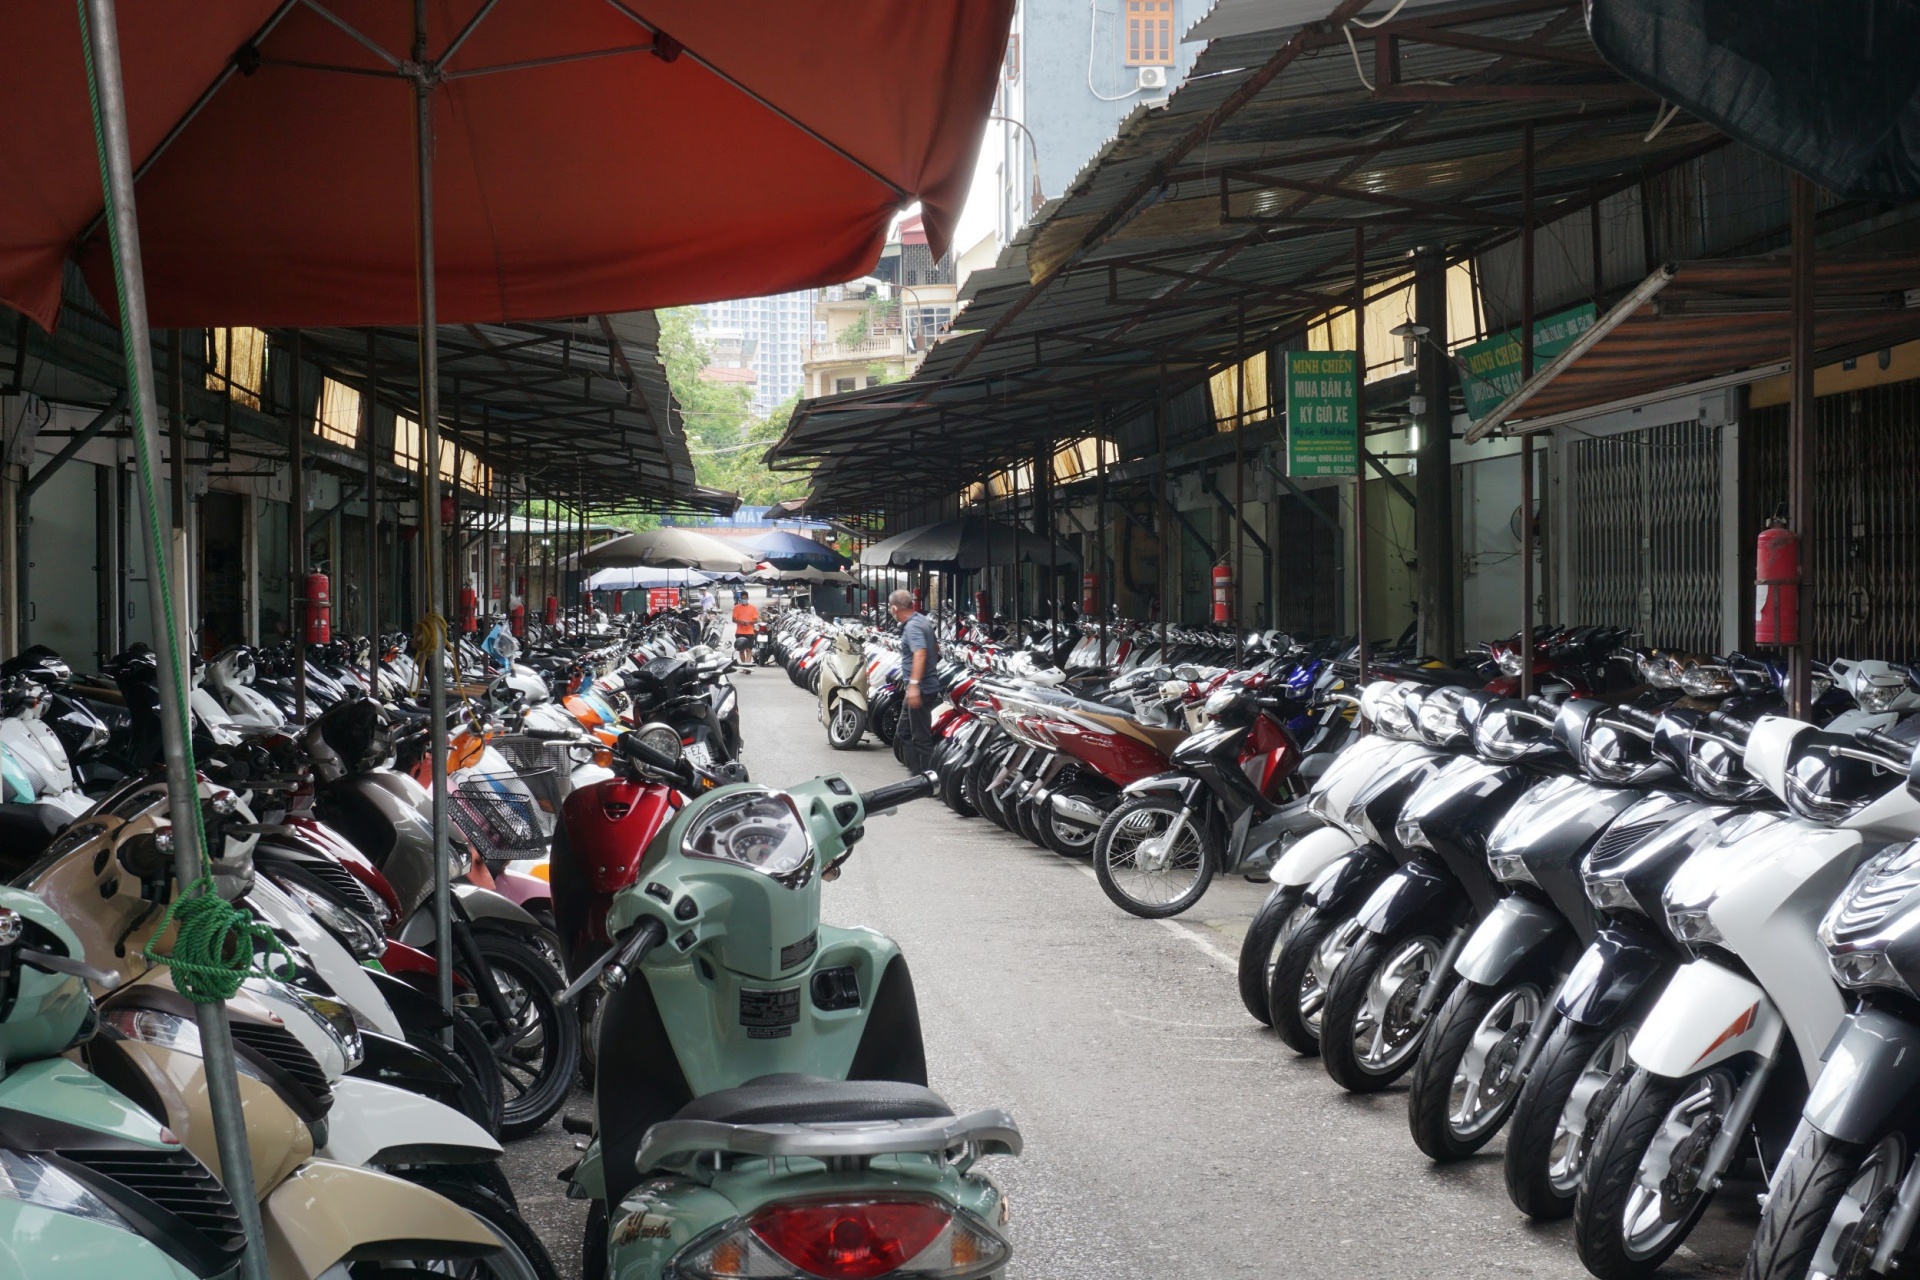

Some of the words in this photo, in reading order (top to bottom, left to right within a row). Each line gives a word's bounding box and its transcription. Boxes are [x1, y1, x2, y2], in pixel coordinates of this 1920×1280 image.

[1293, 359, 1319, 374] MINH
[1321, 353, 1352, 374] CHIẾN
[1469, 350, 1495, 374] MINH
[1295, 381, 1318, 398] MUA
[1320, 376, 1342, 398] BÁN
[1344, 381, 1352, 398] &
[1300, 402, 1313, 423] KÝ
[1316, 399, 1333, 423] GỬI
[1335, 406, 1349, 423] XE
[735, 508, 764, 523] MÁY
